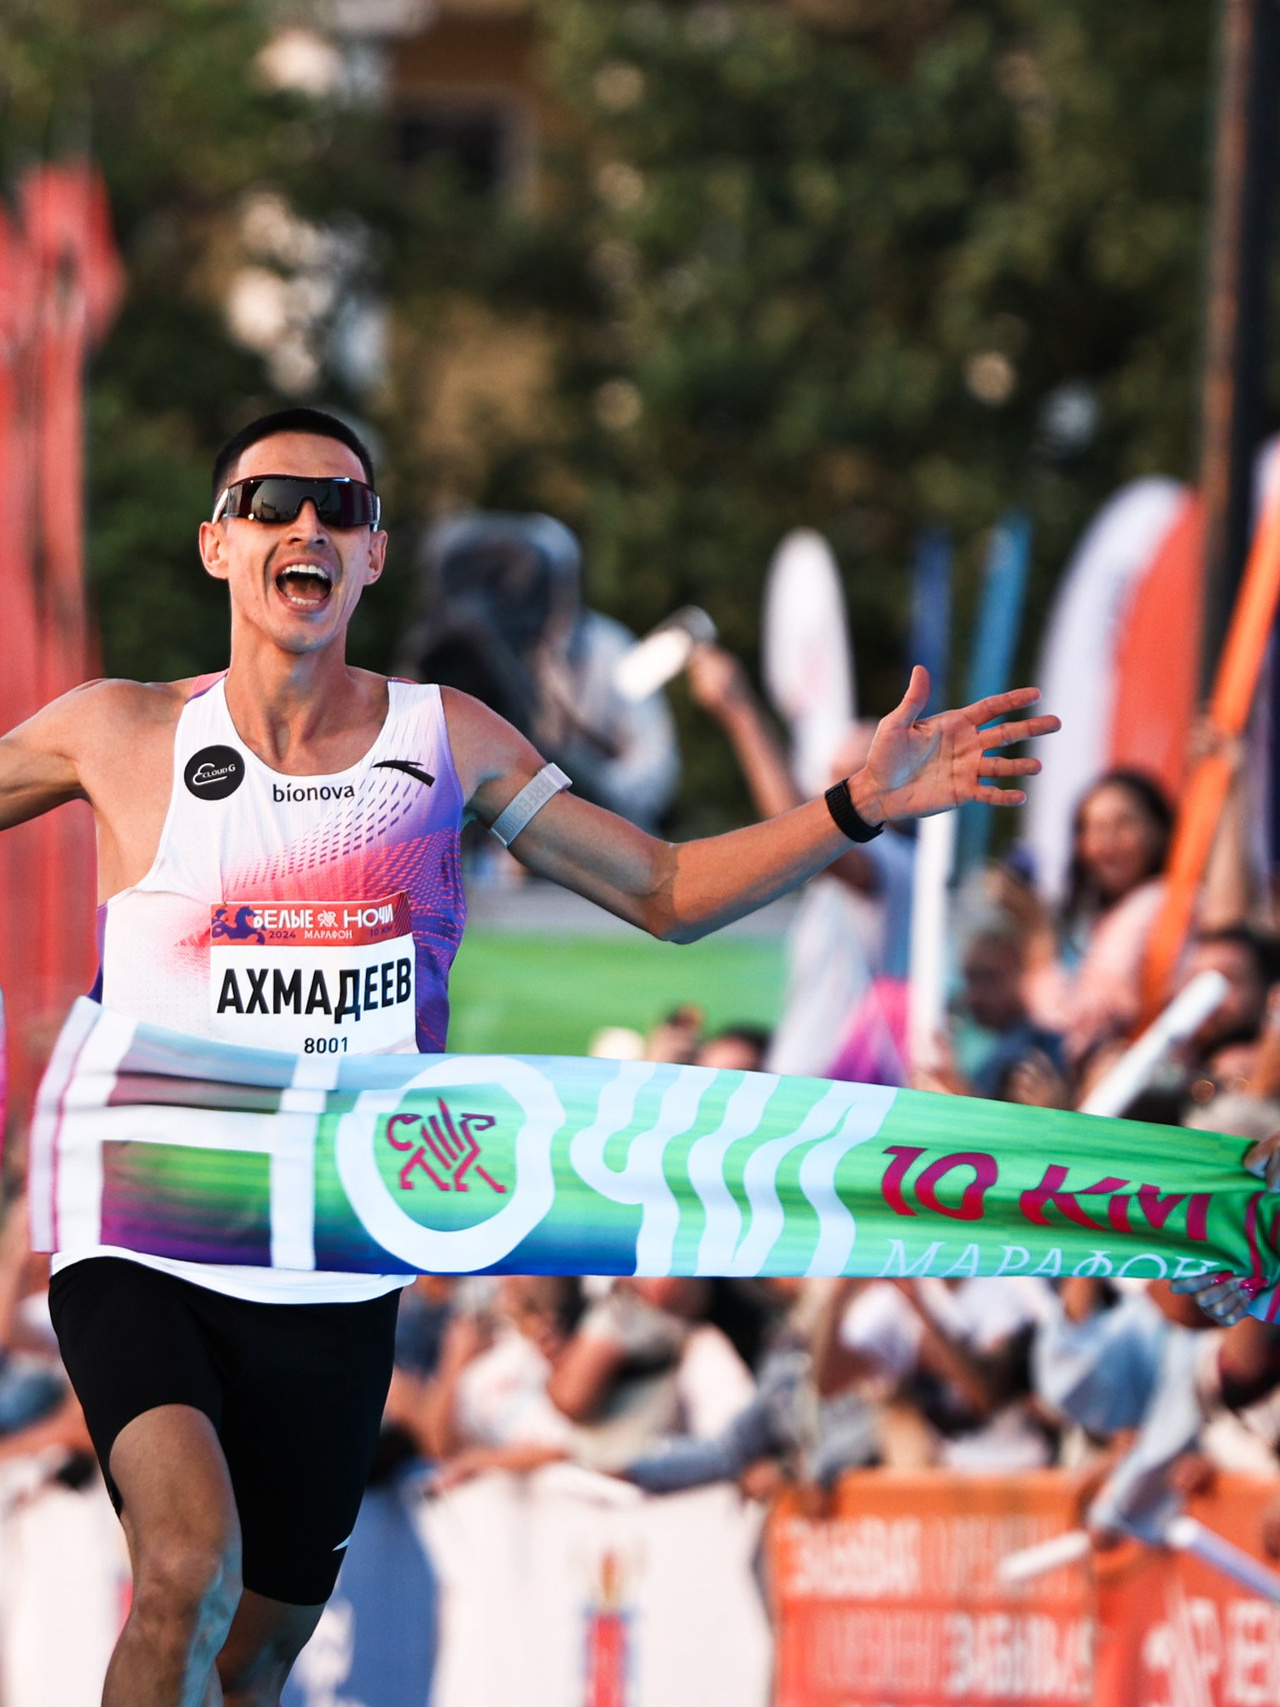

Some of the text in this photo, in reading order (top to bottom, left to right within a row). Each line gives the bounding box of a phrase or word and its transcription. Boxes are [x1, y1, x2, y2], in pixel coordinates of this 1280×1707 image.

[272, 782, 355, 803] bionova
[252, 903, 394, 929] БЕЛЫЕ НОЧИ
[269, 930, 297, 939] 2024
[304, 929, 353, 940] МАРАФОН
[216, 957, 413, 1025] АХМАДЕЕВ
[303, 1037, 348, 1054] 8001
[56, 1007, 900, 1277] НОЧИ
[880, 1144, 999, 1222] 10
